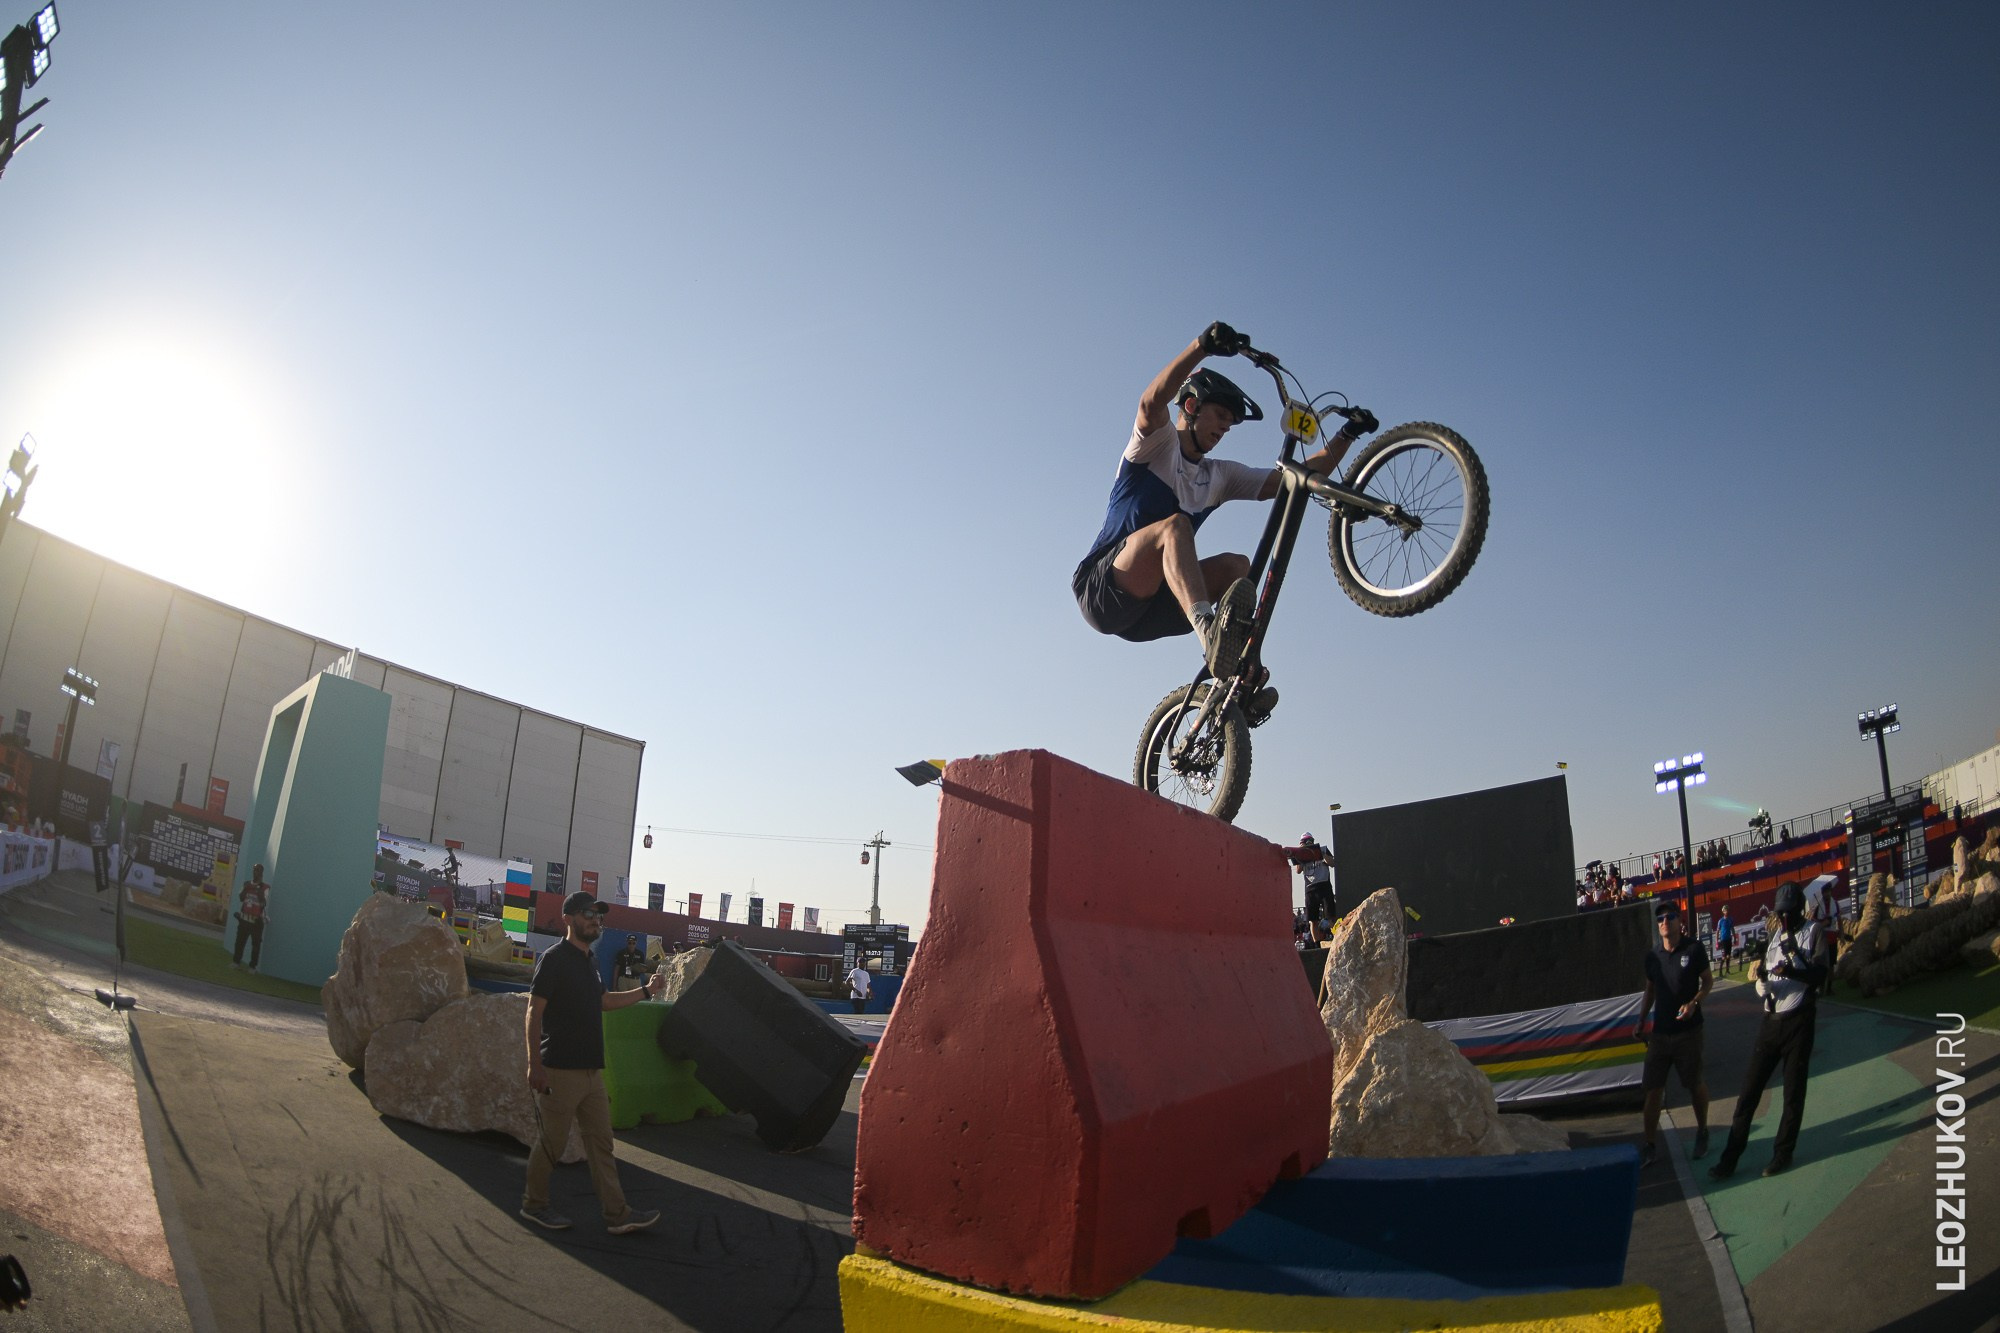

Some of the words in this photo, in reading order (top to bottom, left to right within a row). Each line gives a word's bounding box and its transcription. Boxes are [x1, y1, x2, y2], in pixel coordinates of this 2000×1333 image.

[1297, 416, 1311, 433] 12
[62, 790, 88, 805] RIYADH
[1881, 815, 1898, 826] FINISH
[94, 824, 102, 838] 2
[396, 874, 420, 887] RIYADH
[688, 924, 709, 933] RIYADH
[1702, 923, 1709, 934] 4
